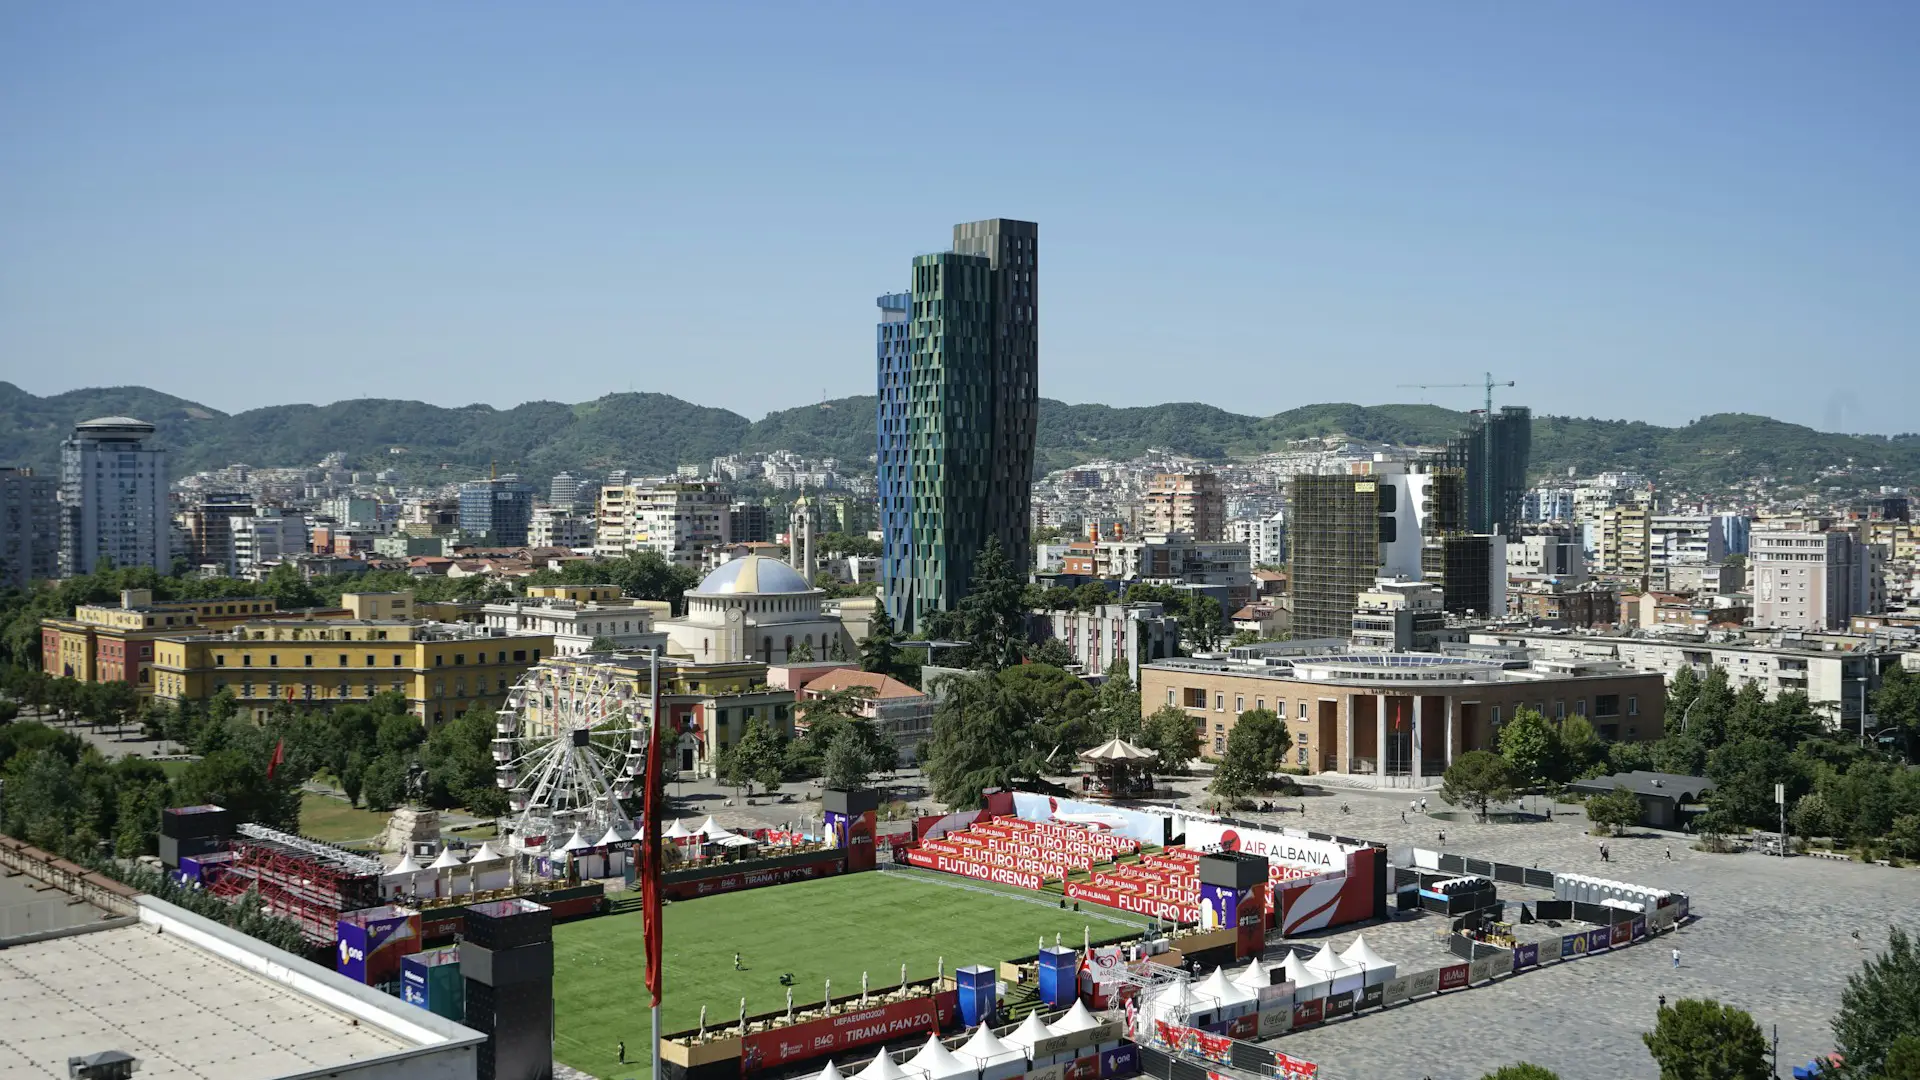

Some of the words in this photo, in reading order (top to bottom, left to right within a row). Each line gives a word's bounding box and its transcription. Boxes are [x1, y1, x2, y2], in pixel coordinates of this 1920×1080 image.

[1012, 831, 1063, 850] FLUTURO
[1065, 841, 1113, 861] KRENAR
[1035, 824, 1086, 841] FLUTURO
[1088, 832, 1136, 851] KRENAR
[938, 845, 957, 853] ALBANIA
[963, 847, 1014, 868] FLUTURO
[1016, 858, 1064, 880] KRENAR
[988, 839, 1039, 859] FLUTURO
[1041, 850, 1089, 870] KRENAR
[1245, 840, 1267, 855] AIR
[1270, 845, 1331, 866] ALBANIA
[744, 873, 773, 885] TIRANA
[912, 854, 932, 864] ALBANIA
[938, 857, 989, 879] FLUTURO
[991, 868, 1039, 889] KRENAR
[1162, 863, 1187, 872] ALBANIA
[1115, 880, 1138, 890] ALBANIA
[1169, 874, 1200, 890] FLUT
[1077, 889, 1088, 897] AIR
[1087, 891, 1111, 901] ALBANIA
[1118, 894, 1180, 919] FLUTURO
[376, 924, 392, 932] one
[348, 947, 363, 961] one
[846, 1024, 887, 1042] TIRANA
[889, 1018, 912, 1033] FAN
[913, 1009, 945, 1027] ZOE
[1117, 1053, 1131, 1064] one
